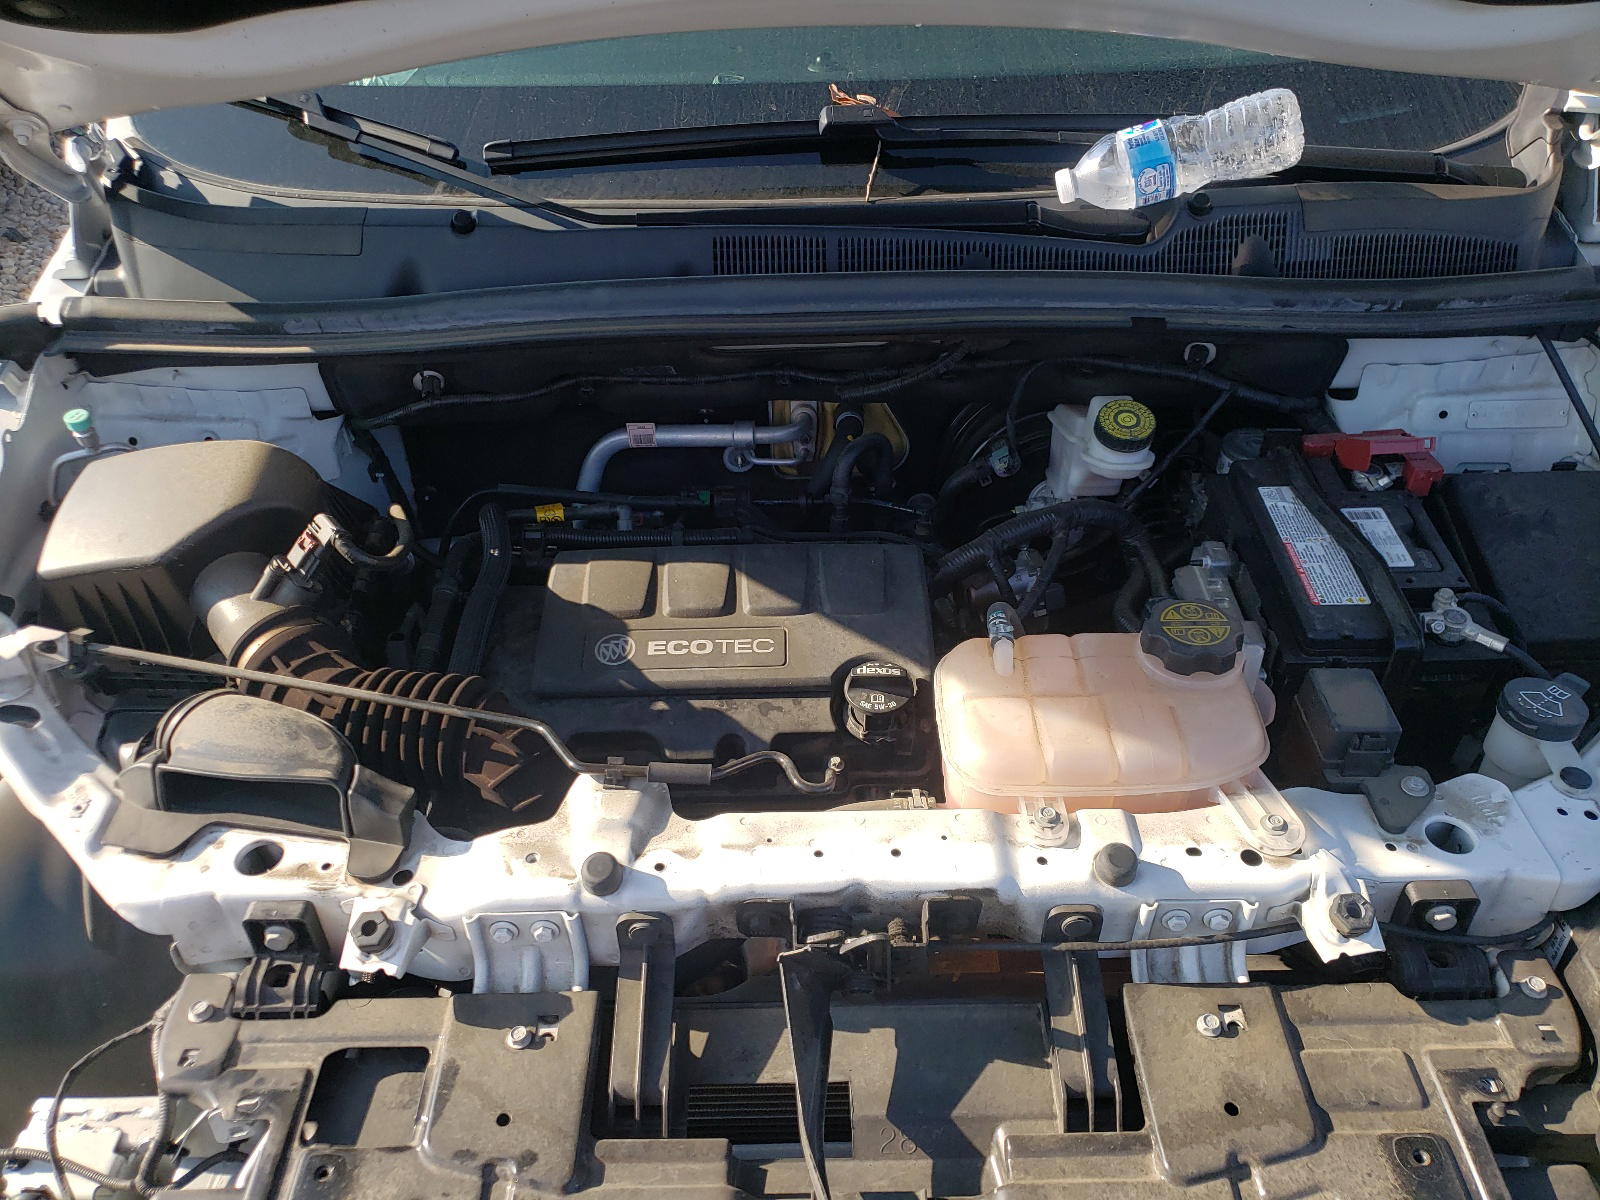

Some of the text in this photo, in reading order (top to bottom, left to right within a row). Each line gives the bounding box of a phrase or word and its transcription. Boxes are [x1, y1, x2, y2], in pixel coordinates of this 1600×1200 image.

[647, 638, 775, 656] ECOTEC
[856, 665, 901, 676] dexos
[859, 700, 897, 710] SAE 5W-30
